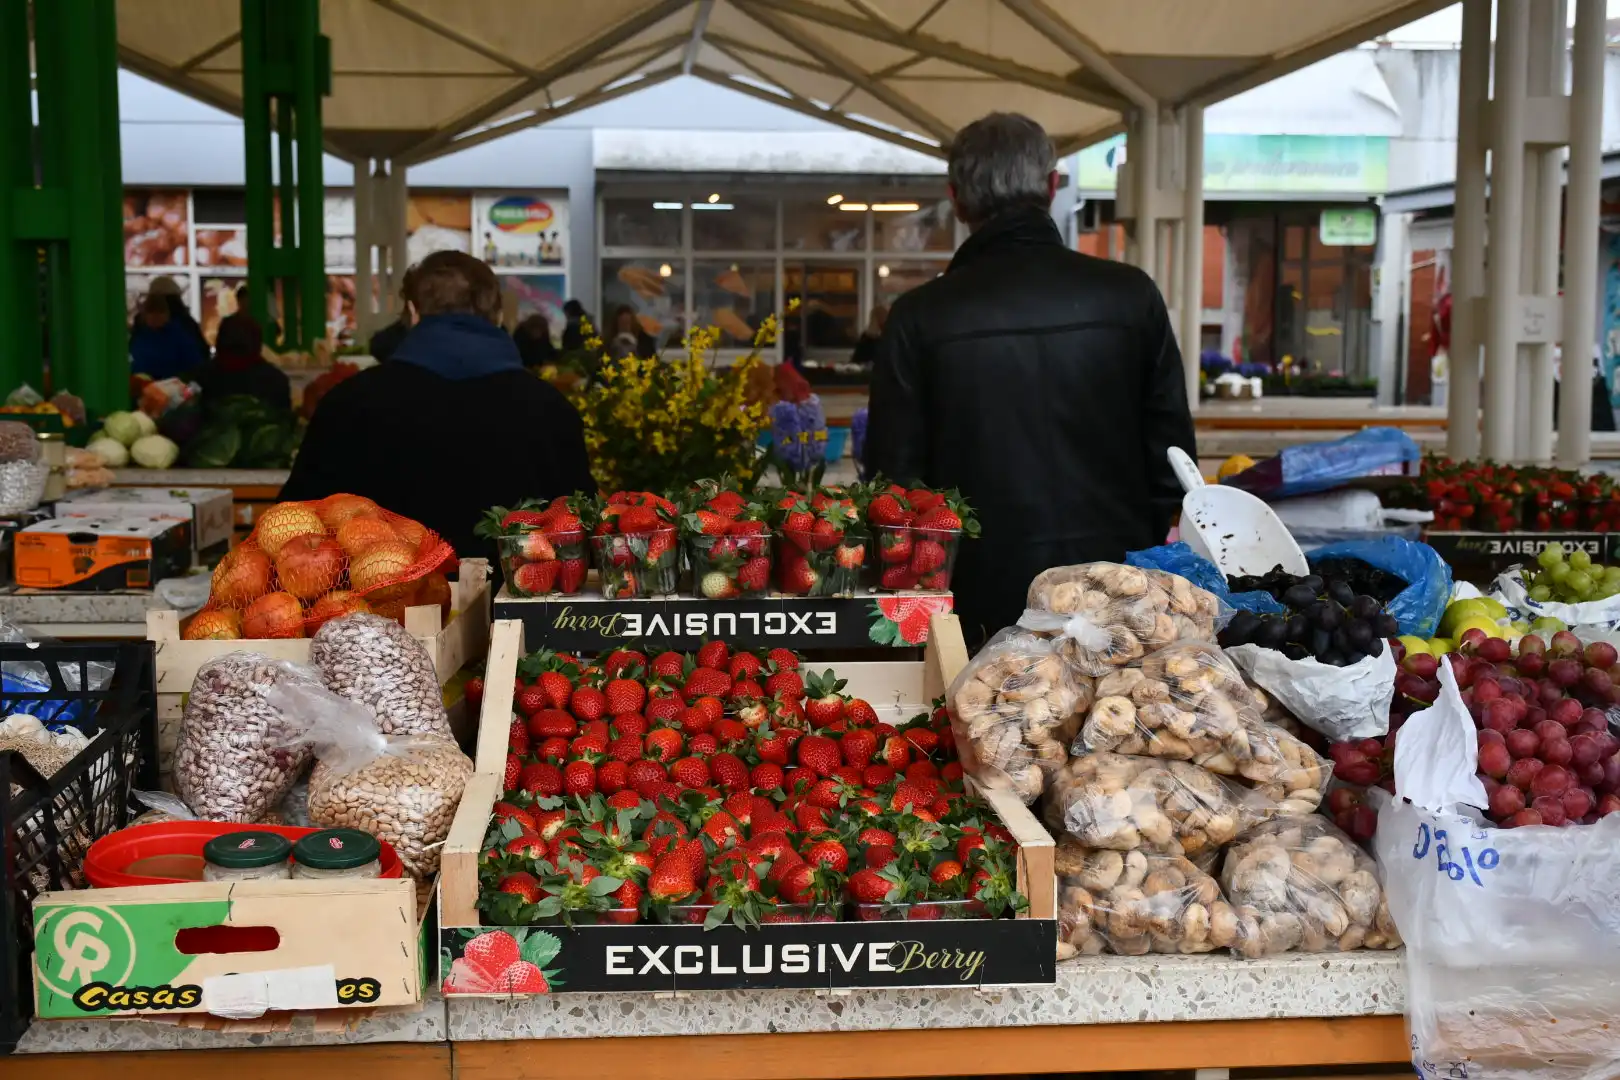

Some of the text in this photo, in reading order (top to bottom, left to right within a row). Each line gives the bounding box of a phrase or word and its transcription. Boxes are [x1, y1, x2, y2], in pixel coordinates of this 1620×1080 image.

[1490, 540, 1599, 555] EXCUSIVE
[552, 606, 837, 638] EXCLUSIVE Berry
[605, 940, 986, 981] EXCLUSIVE Berry
[77, 984, 201, 1009] Casas
